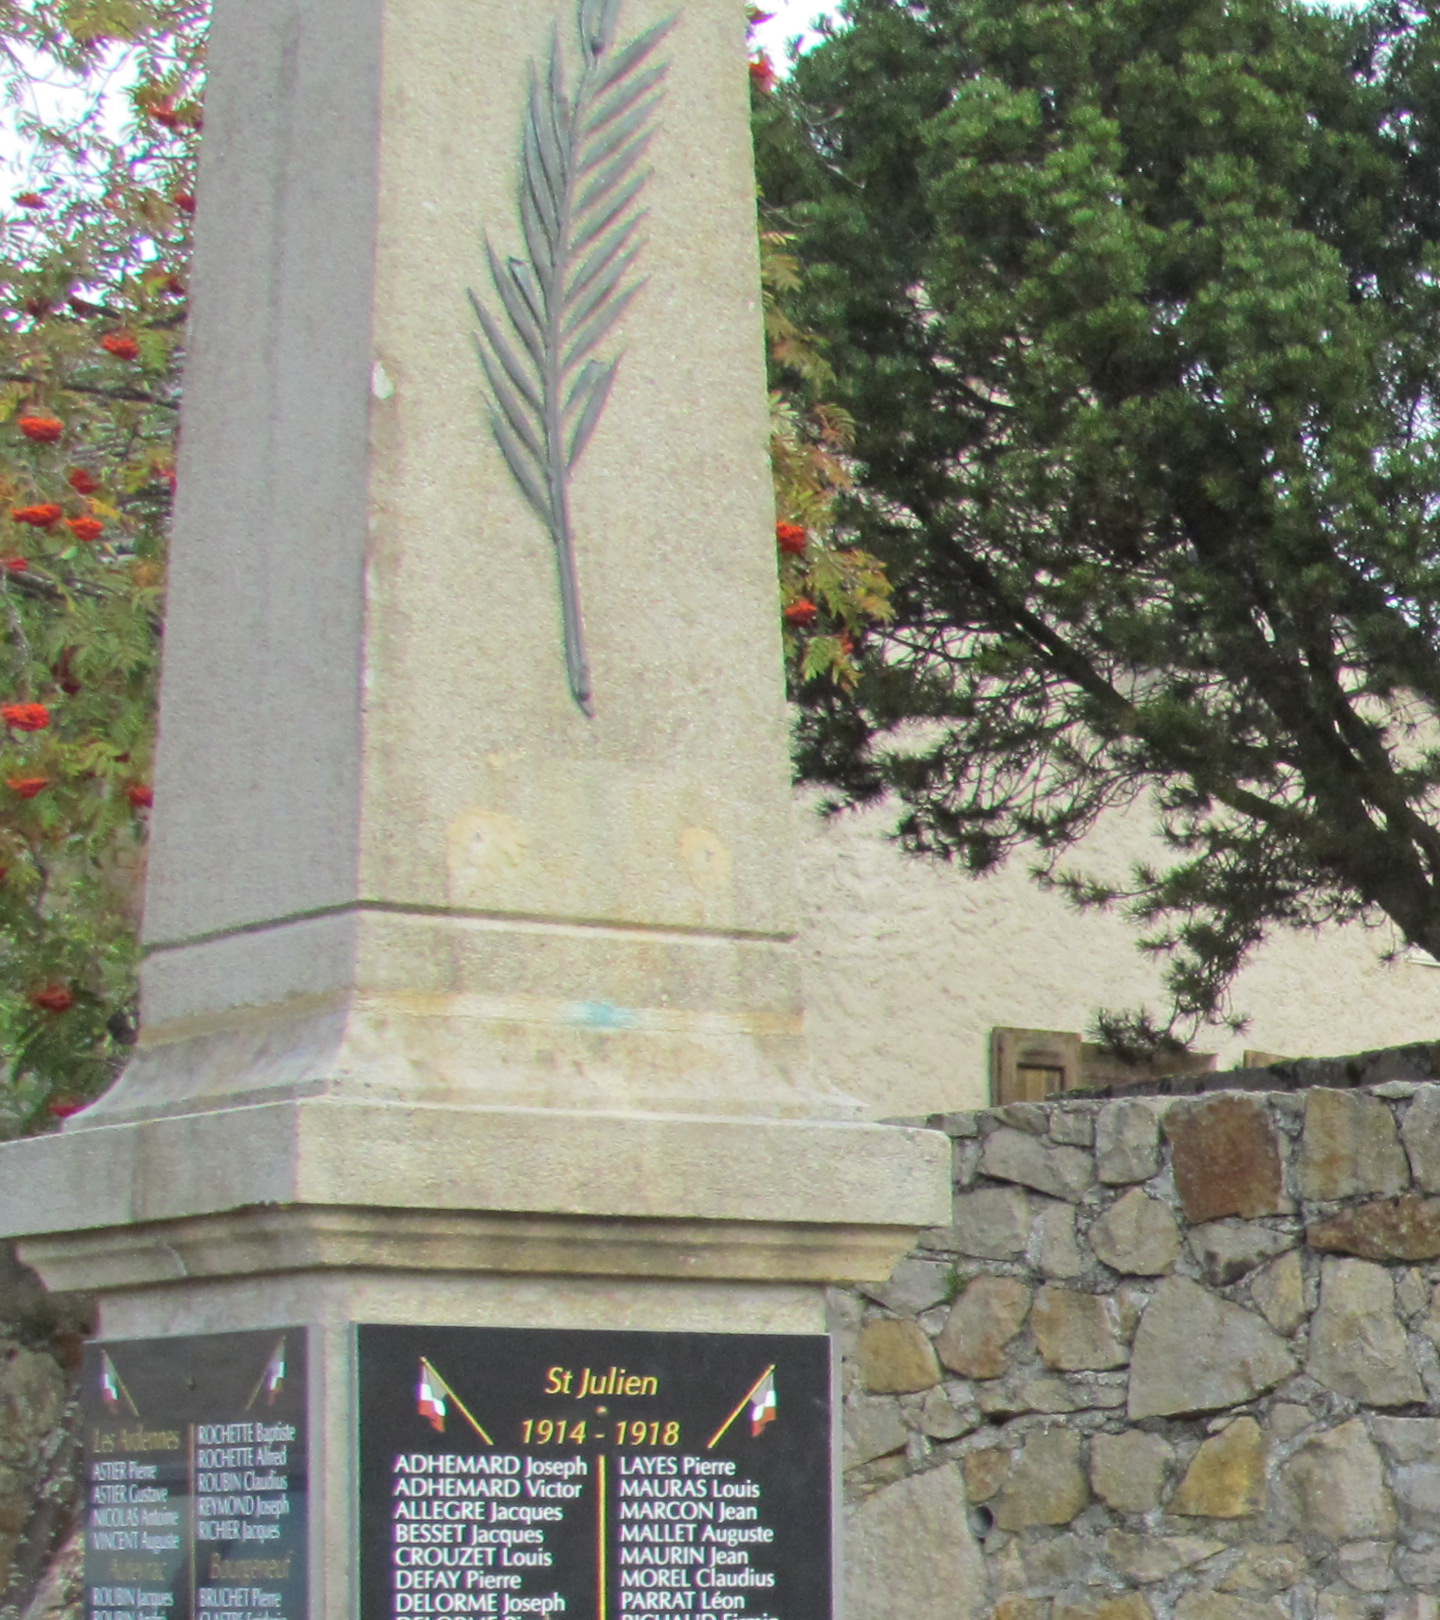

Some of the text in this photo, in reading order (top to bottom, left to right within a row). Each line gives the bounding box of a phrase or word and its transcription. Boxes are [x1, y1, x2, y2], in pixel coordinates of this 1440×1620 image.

[544, 1366, 658, 1399] St Julien
[199, 1424, 254, 1444] ROCHETTE
[521, 1419, 587, 1444] 1914
[616, 1420, 680, 1446] 1918
[199, 1448, 254, 1468] ROCHETTE
[394, 1454, 588, 1479] ADHEMARD Joseph
[619, 1456, 736, 1475] LAYES Pierre
[394, 1478, 583, 1498] ADHEMARD Victor
[620, 1479, 760, 1498] MAURAS Louis
[394, 1501, 563, 1524] ALLEGRE Jacques
[620, 1501, 757, 1522] MARCON Jean
[395, 1524, 544, 1547] BESSET Jacques
[620, 1524, 774, 1547] MALLET Auguste
[395, 1547, 552, 1567] CROUZET Louis
[620, 1547, 748, 1567] MAURIN Jean
[395, 1570, 522, 1589] DEFAY Pierre
[620, 1567, 775, 1588] MOREL Claudius
[395, 1592, 565, 1615] DELORME Joseph
[621, 1590, 745, 1610] PARRAT Léon
